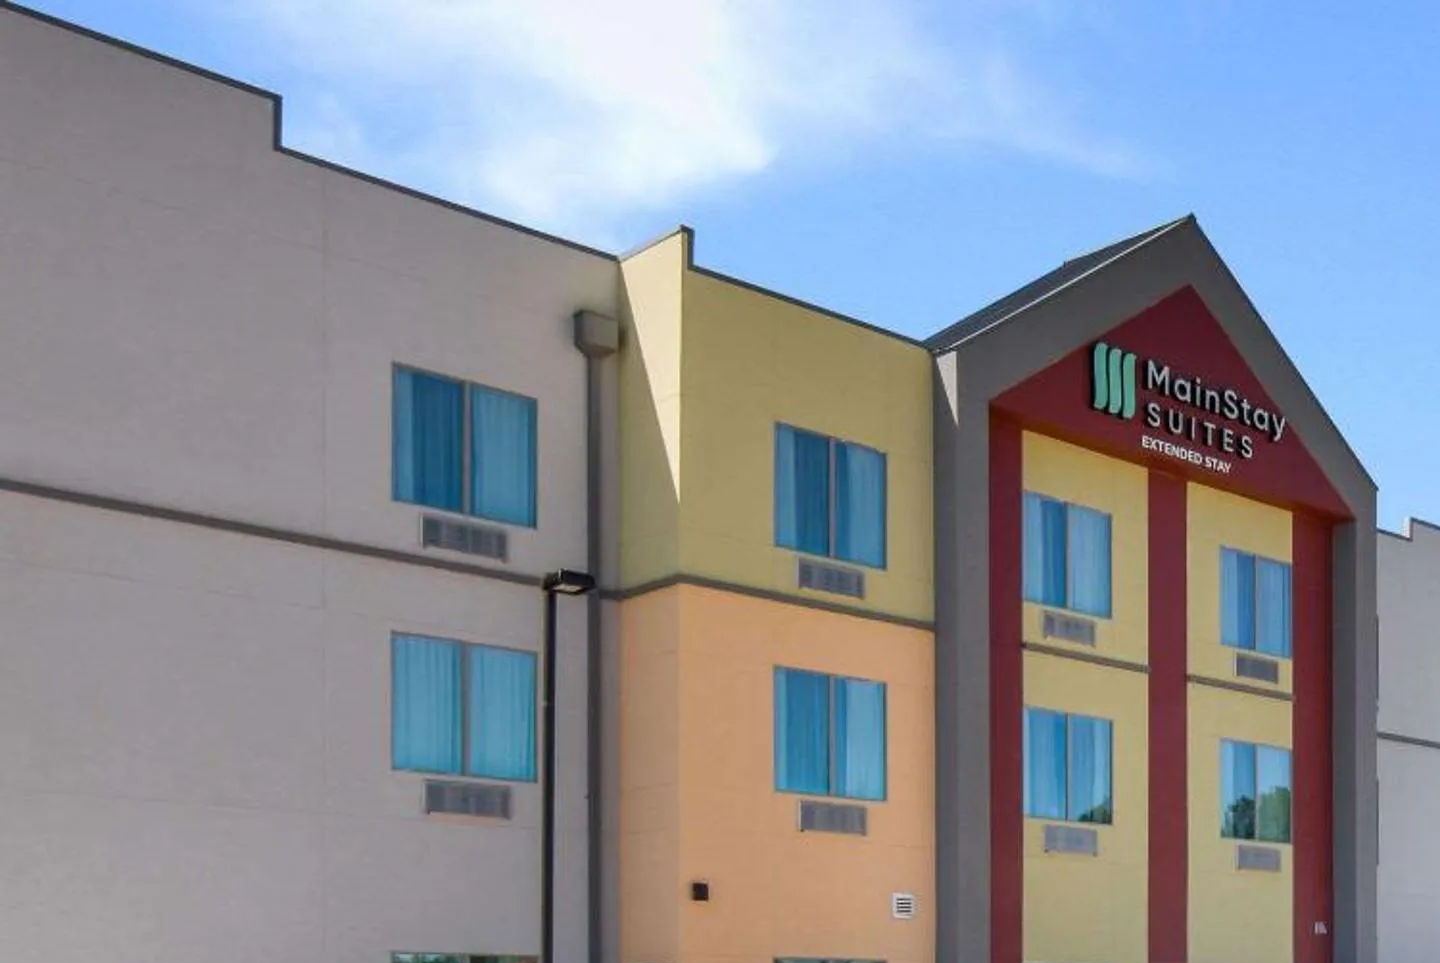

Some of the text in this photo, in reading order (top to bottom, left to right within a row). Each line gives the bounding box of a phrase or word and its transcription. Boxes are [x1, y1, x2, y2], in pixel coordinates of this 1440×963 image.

[1146, 359, 1286, 442] MainStay
[1141, 435, 1232, 473] EXTENDED STAY
[1146, 403, 1253, 458] SUITES
